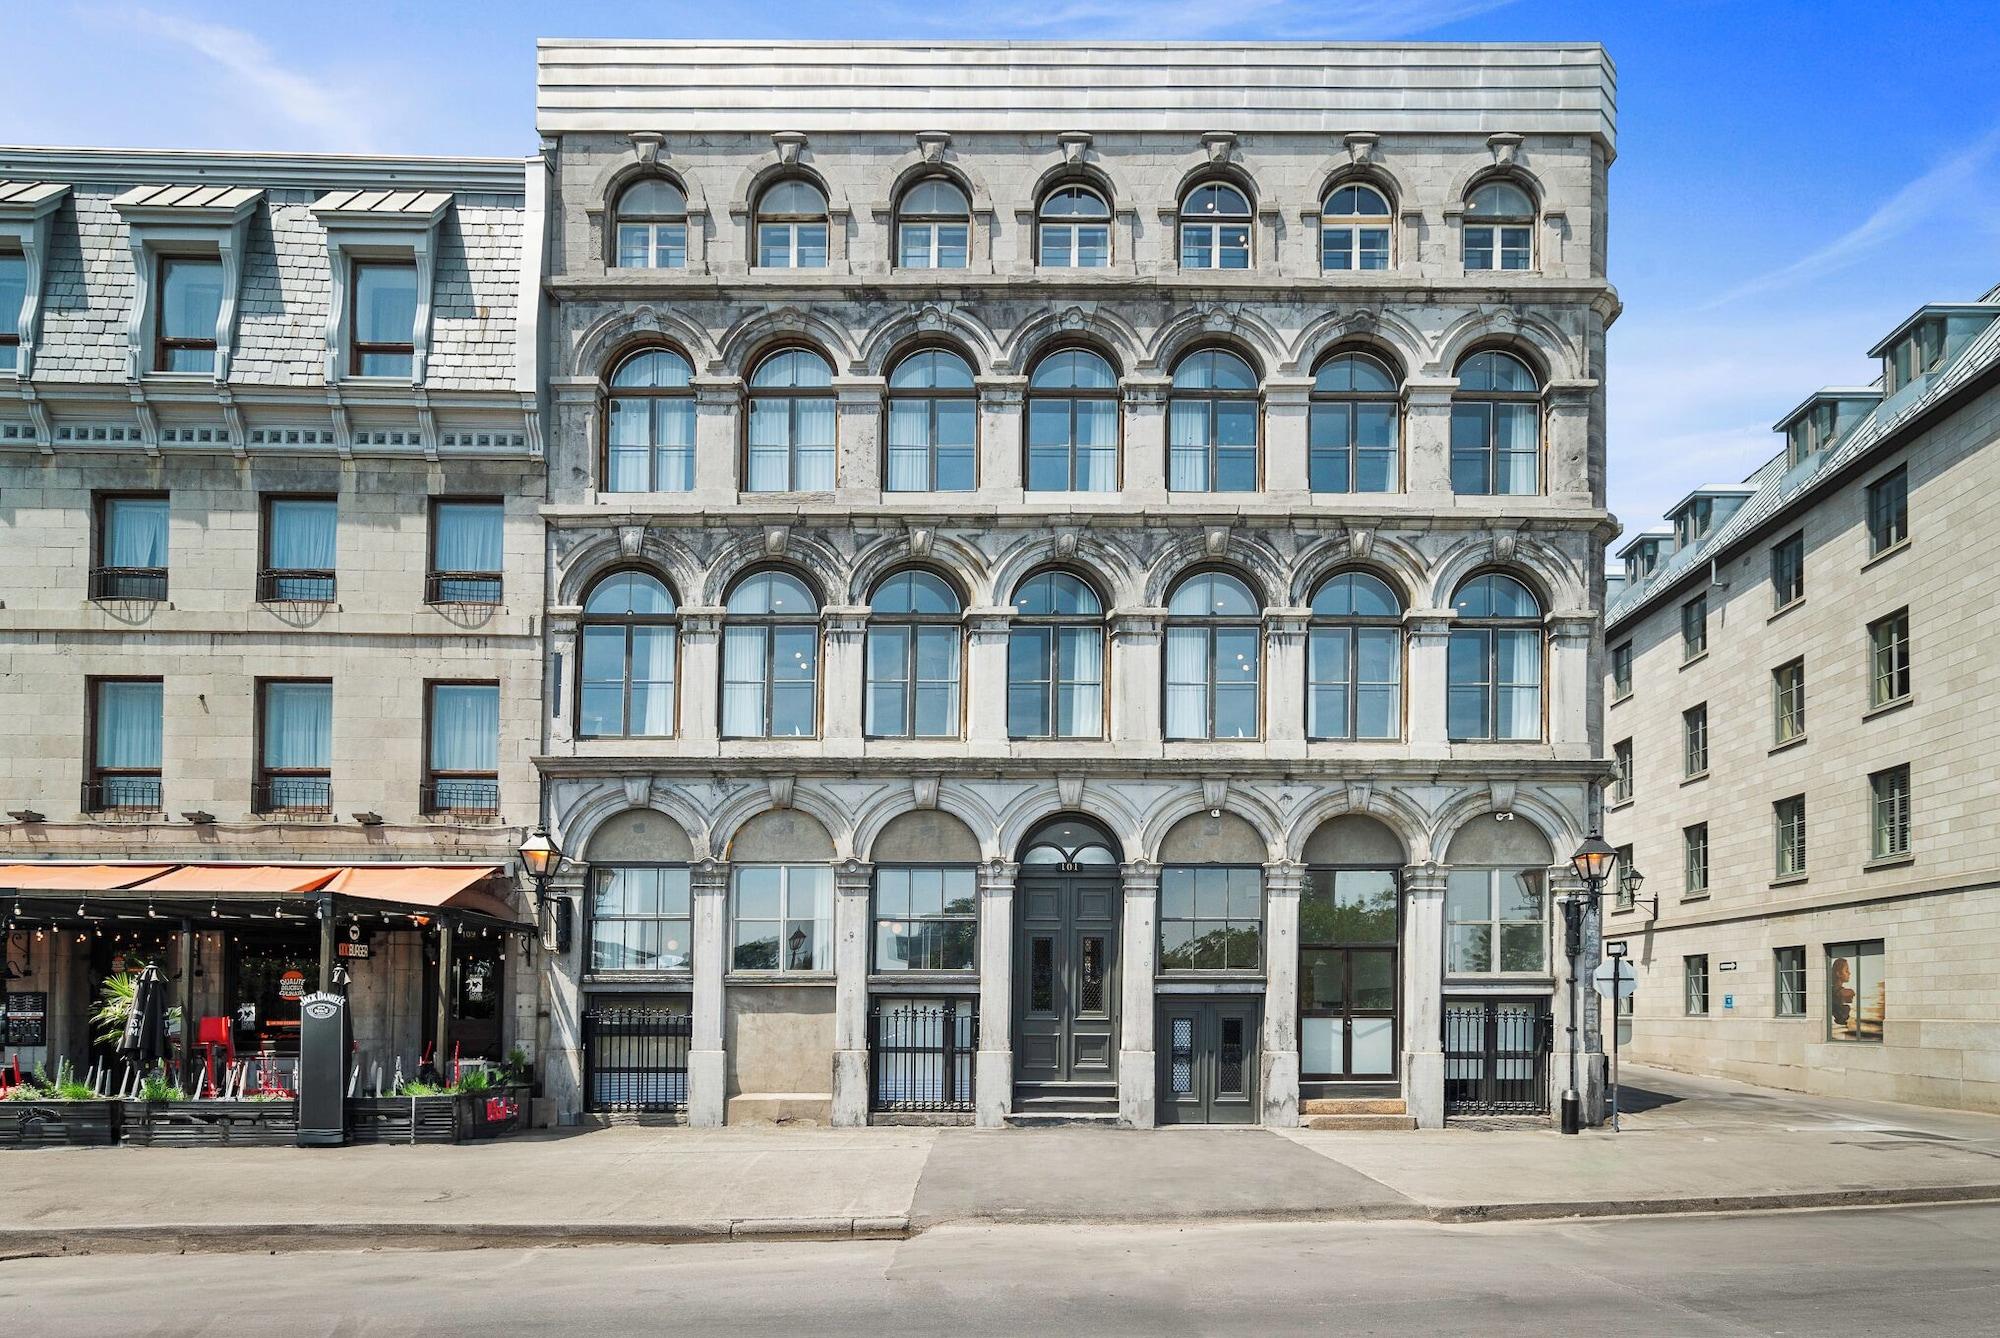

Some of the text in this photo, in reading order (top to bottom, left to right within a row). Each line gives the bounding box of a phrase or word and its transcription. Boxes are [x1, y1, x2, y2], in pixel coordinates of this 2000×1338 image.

[1061, 863, 1078, 871] 101
[463, 930, 476, 938] 109
[300, 993, 317, 1006] JACK
